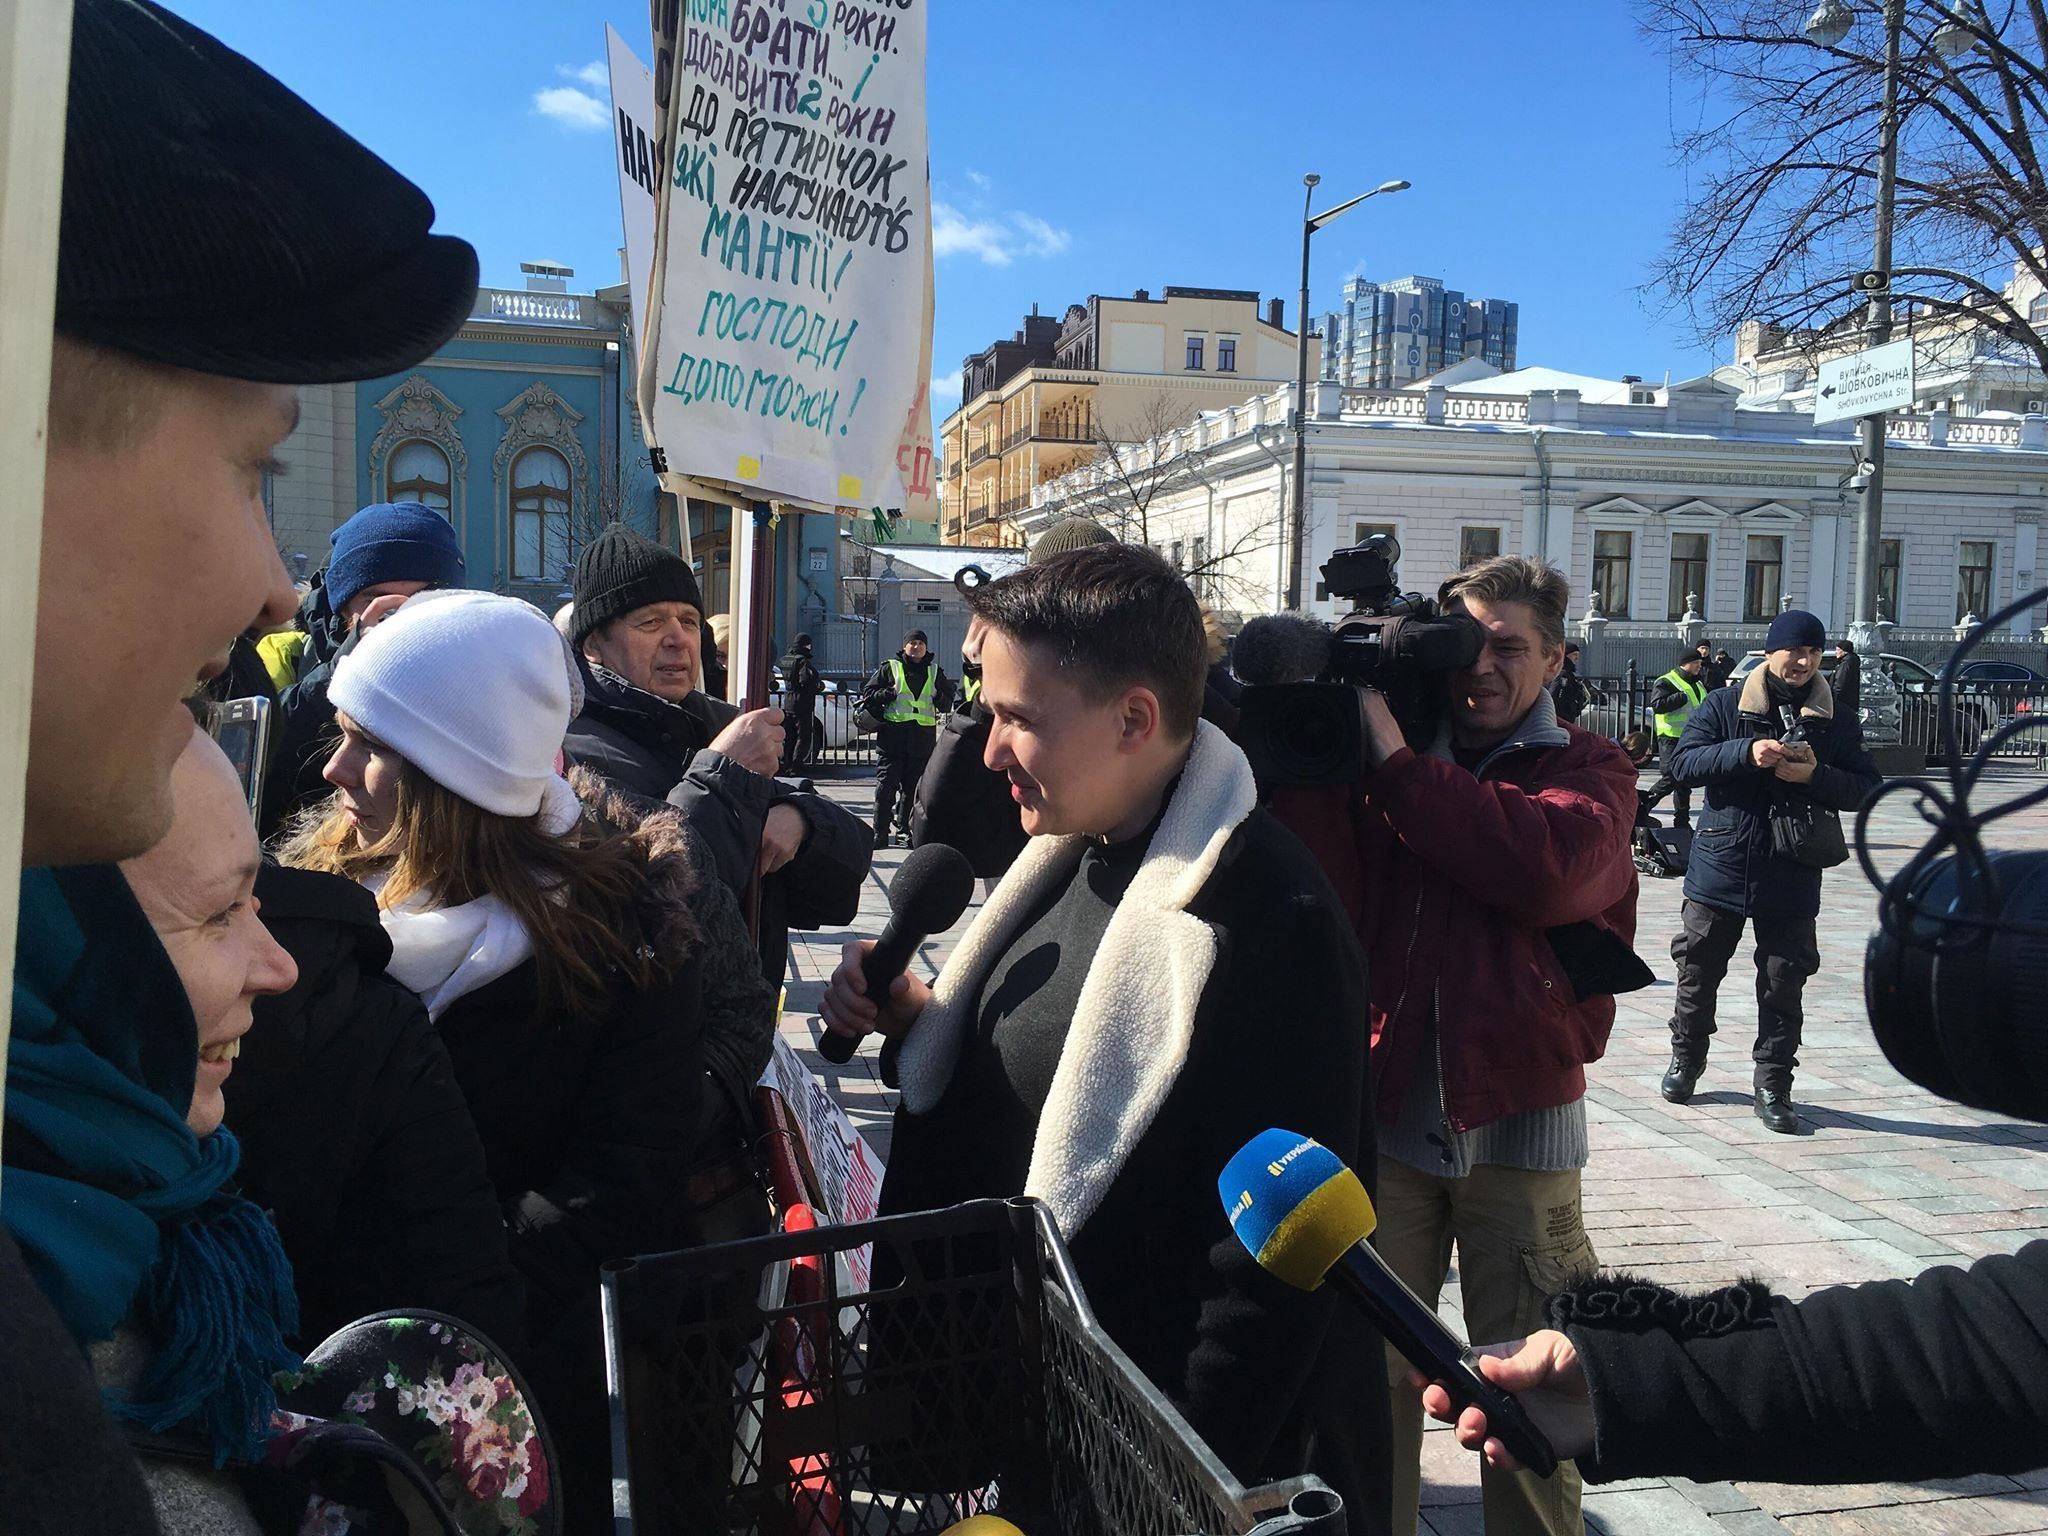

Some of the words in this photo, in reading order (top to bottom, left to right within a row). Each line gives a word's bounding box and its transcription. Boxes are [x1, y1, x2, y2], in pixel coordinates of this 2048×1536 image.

[681, 84, 719, 142] ДО
[683, 27, 801, 114] ДОБАВИТЬ
[797, 79, 823, 121] 2
[826, 96, 896, 145] РОКИ
[672, 142, 718, 208] ЯКІ
[1837, 391, 1893, 410] SHOVKOVYCHNA
[1838, 367, 1909, 395] ШОВКОВИЧНА
